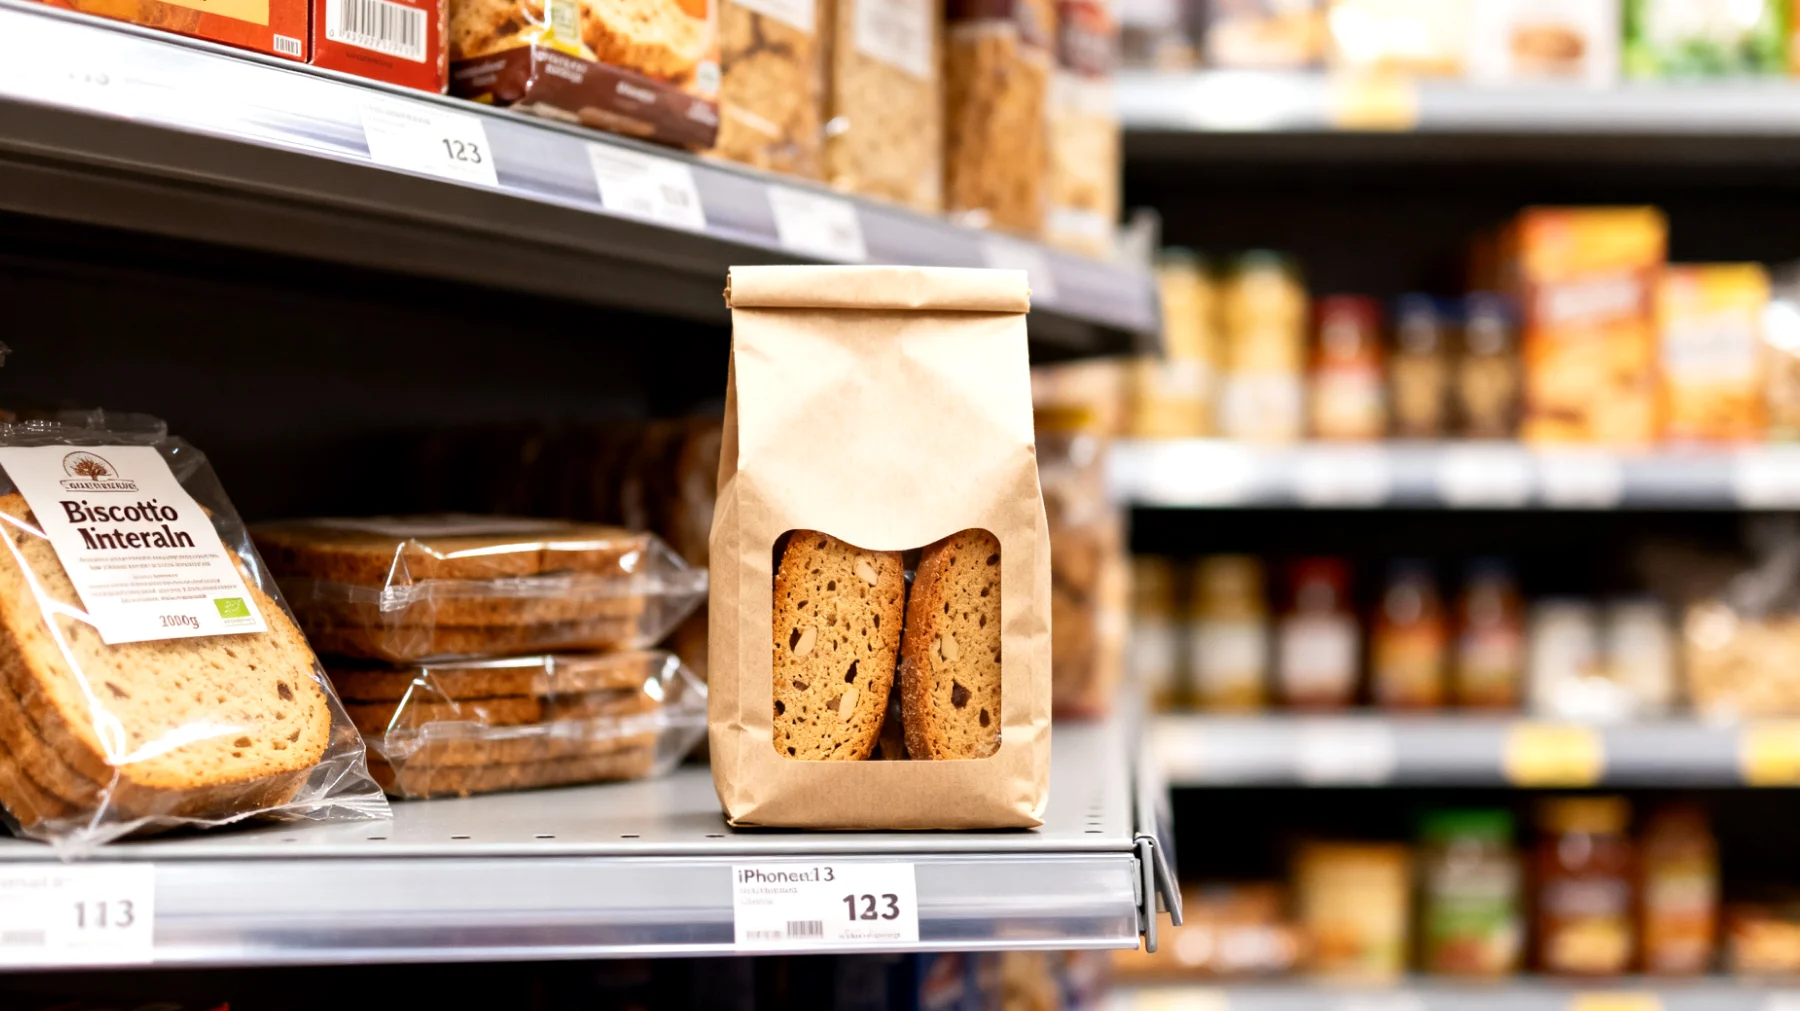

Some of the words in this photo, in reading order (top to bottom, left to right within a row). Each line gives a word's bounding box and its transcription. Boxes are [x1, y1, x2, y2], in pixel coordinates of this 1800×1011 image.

[441, 137, 482, 164] 123
[59, 498, 178, 523] Biscotto
[843, 893, 900, 921] 123
